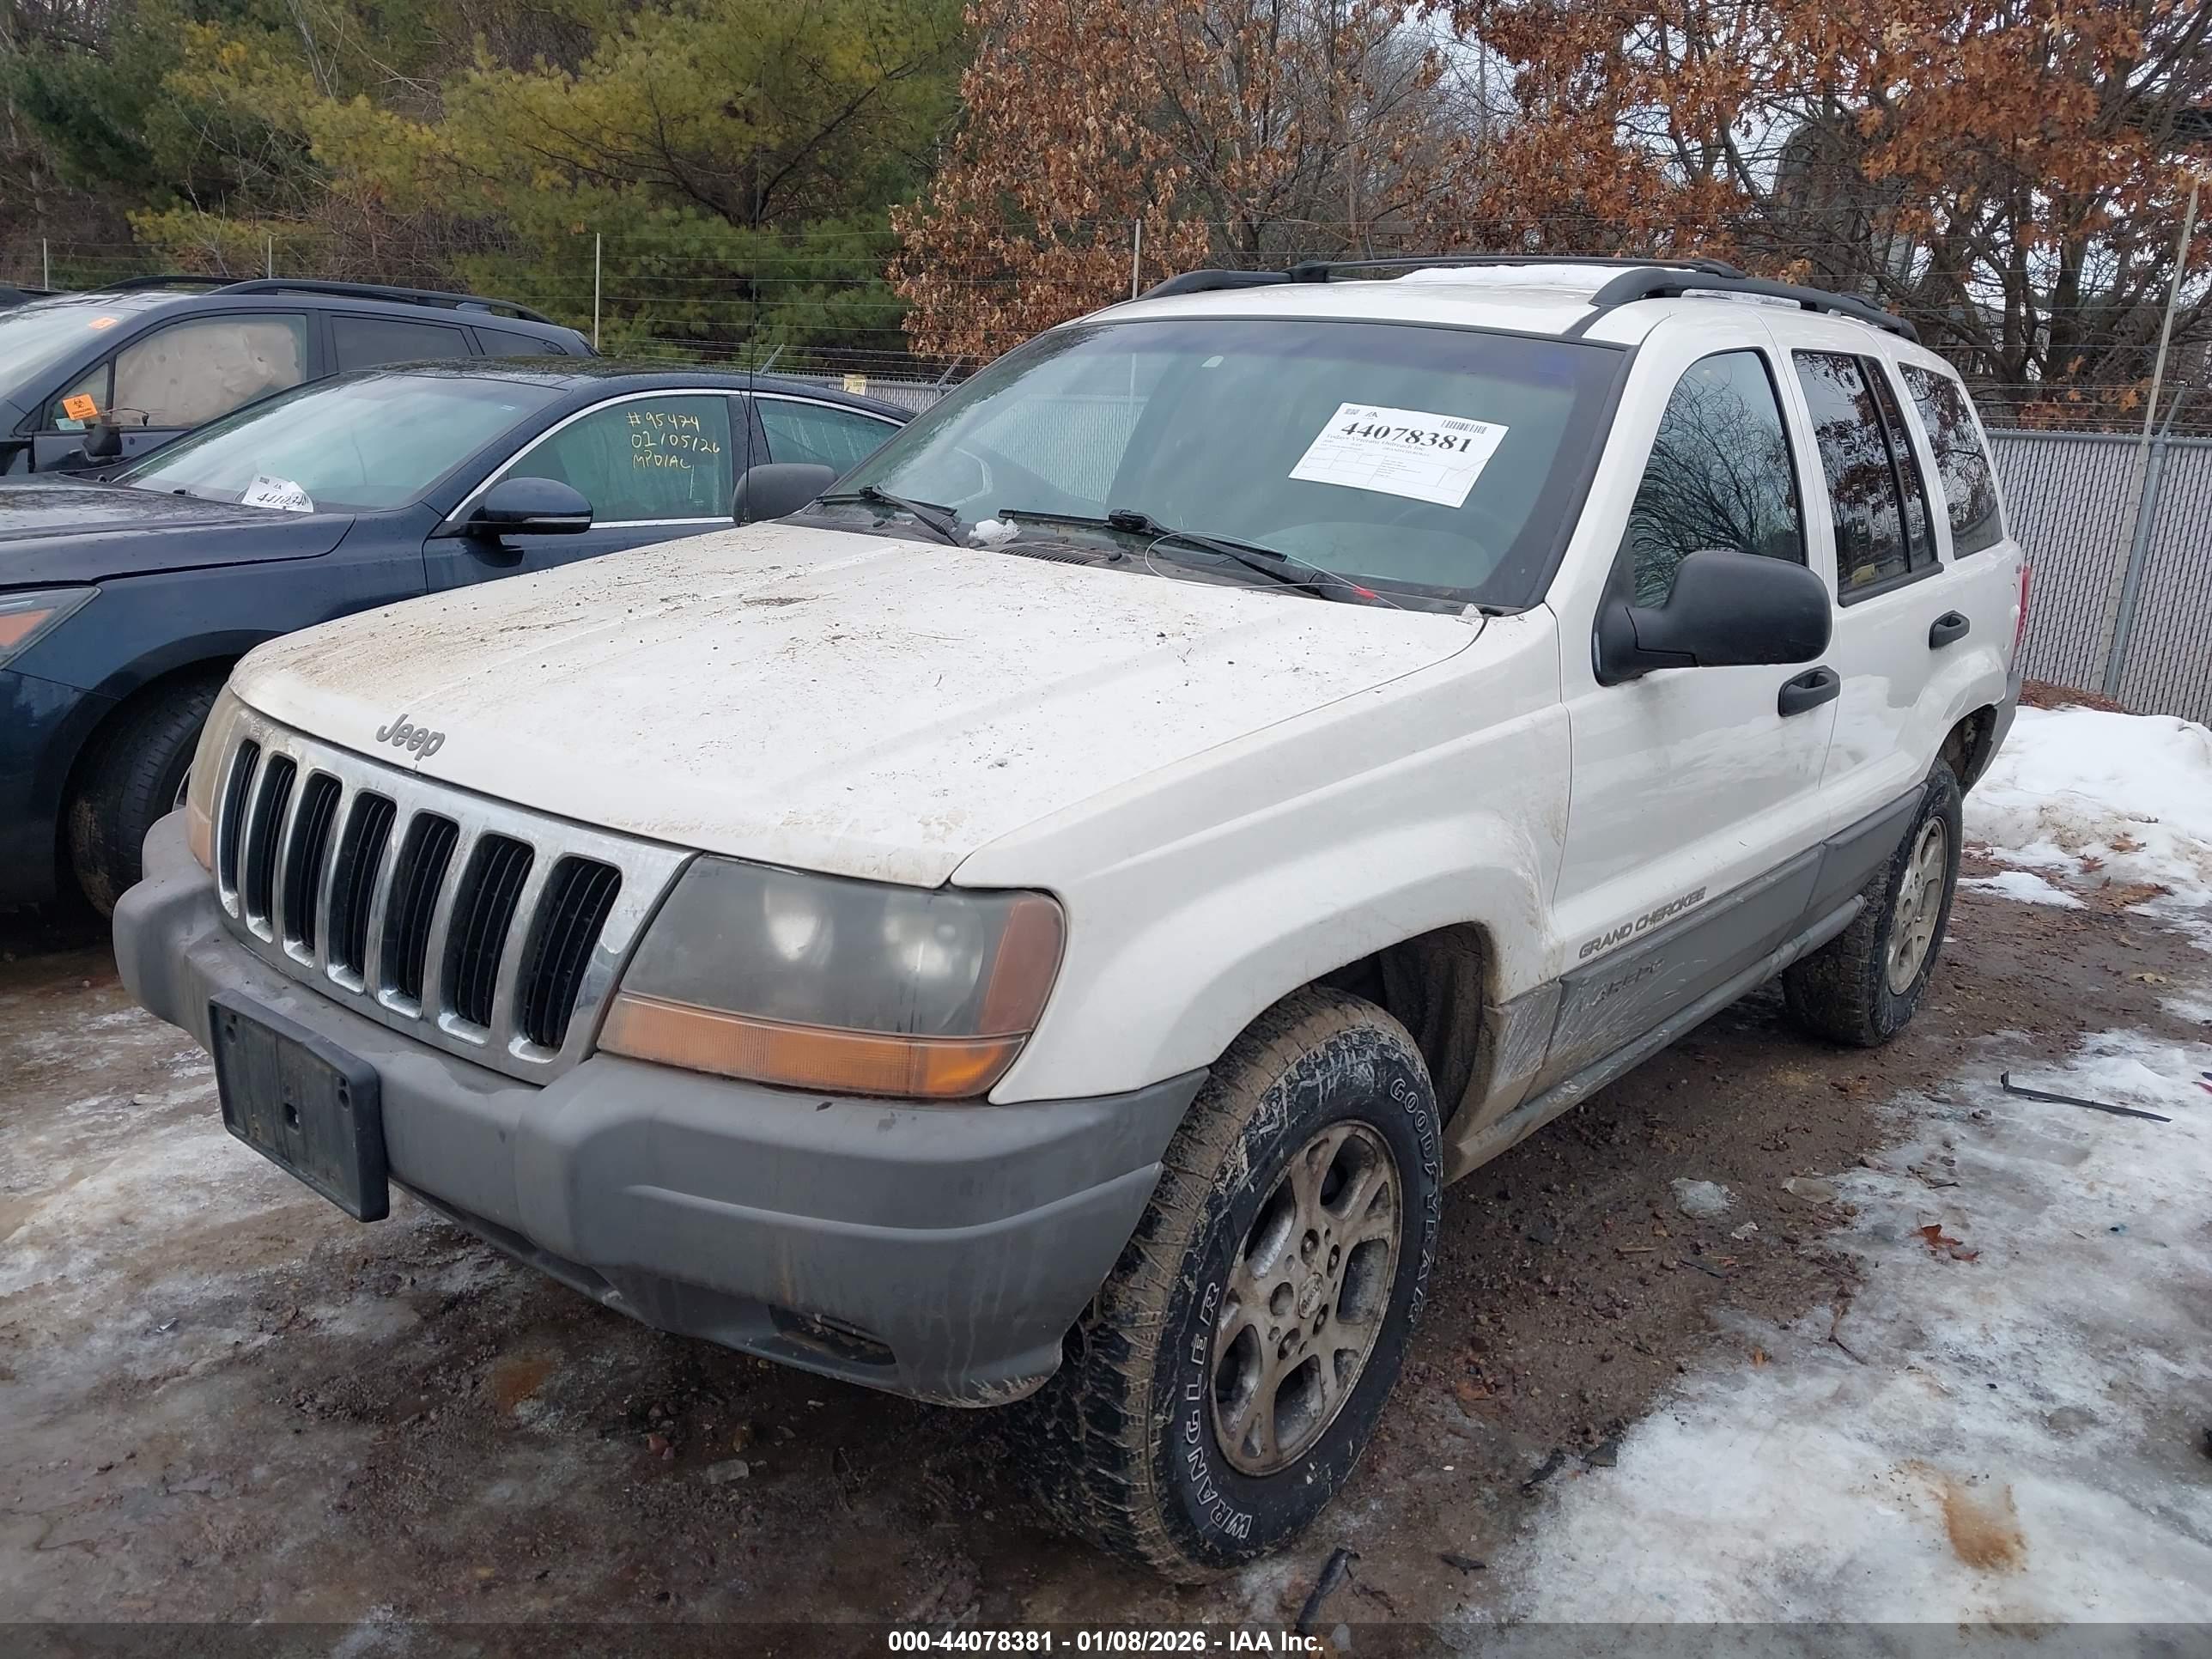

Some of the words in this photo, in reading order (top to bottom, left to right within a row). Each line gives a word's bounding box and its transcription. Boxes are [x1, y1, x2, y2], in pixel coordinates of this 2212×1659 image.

[1340, 421, 1473, 453] 44078381
[375, 713, 446, 762] Jeep
[1578, 921, 1633, 959] GRAND
[1635, 885, 1707, 932] CHEROKEE
[1185, 1281, 1253, 1540] WRANGLER
